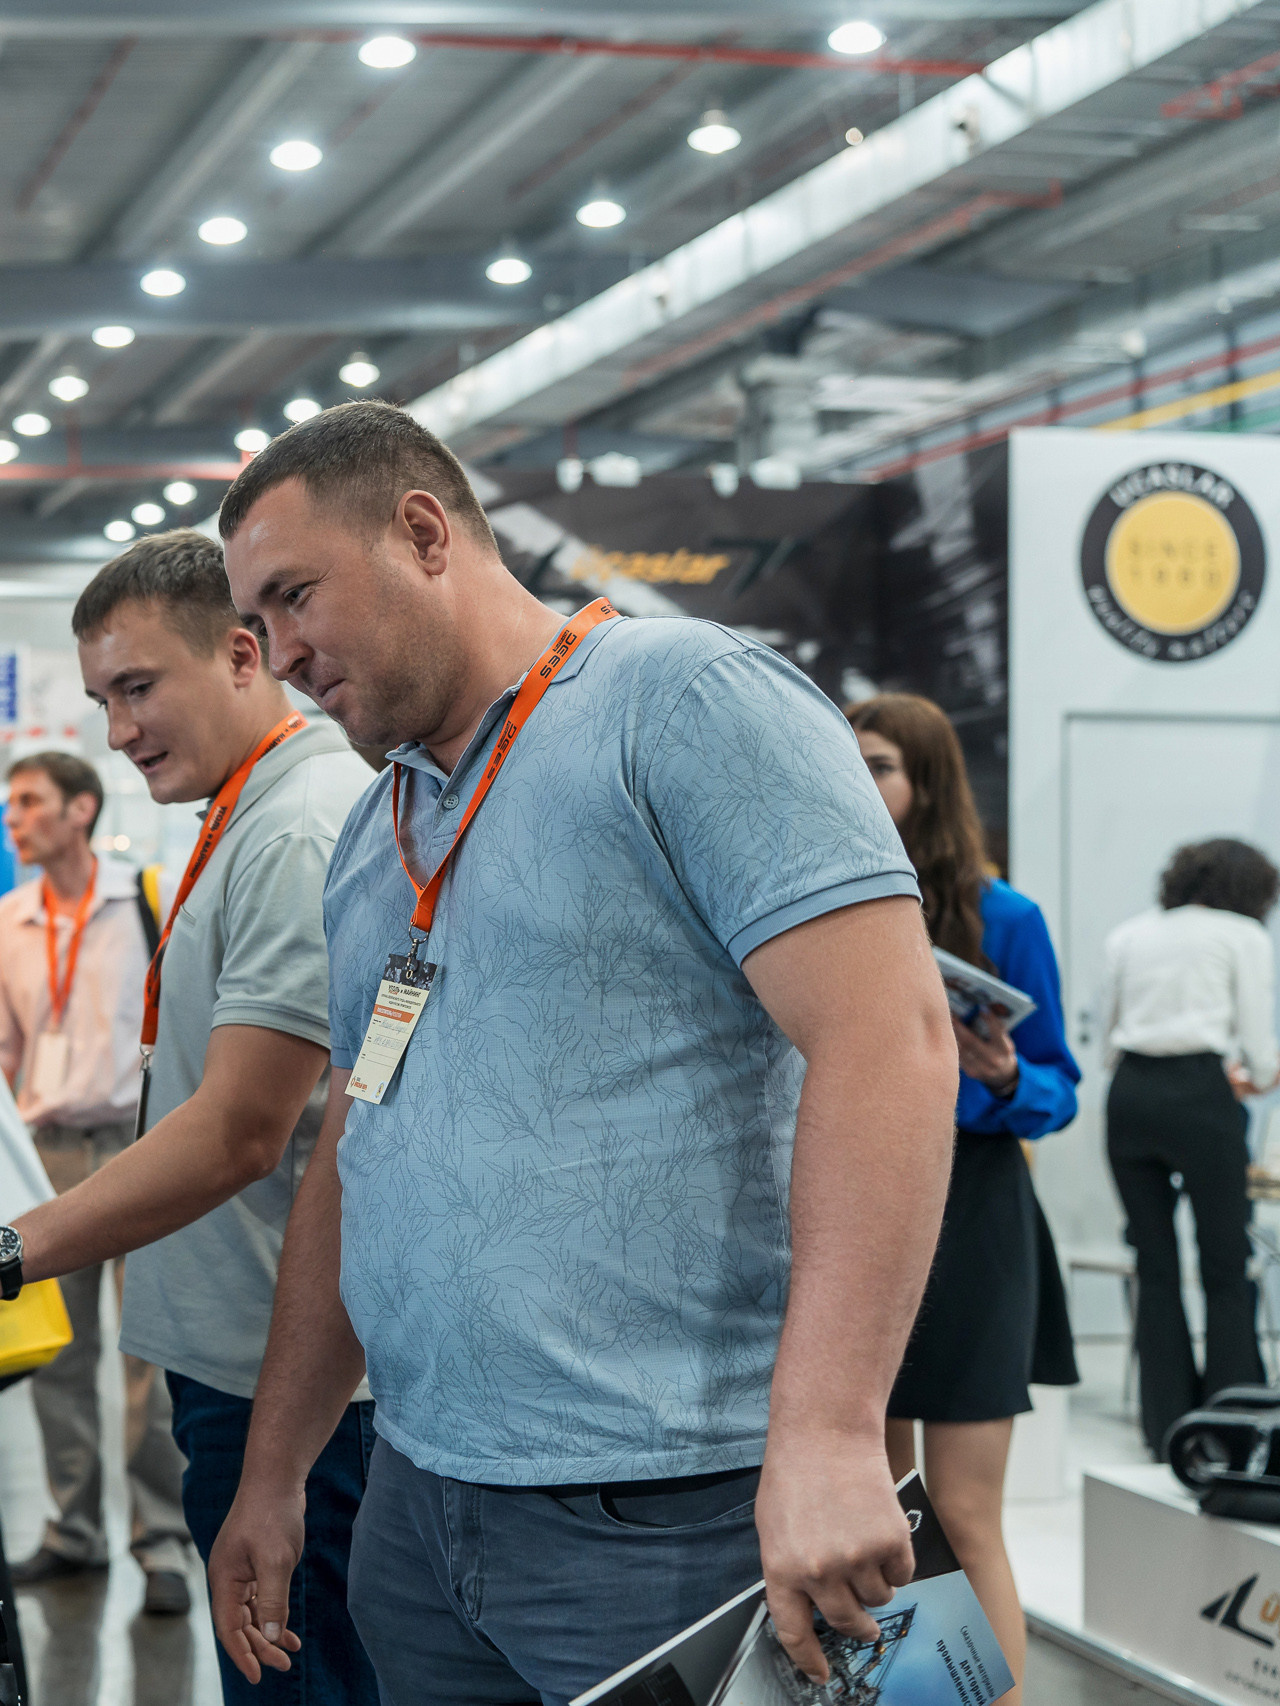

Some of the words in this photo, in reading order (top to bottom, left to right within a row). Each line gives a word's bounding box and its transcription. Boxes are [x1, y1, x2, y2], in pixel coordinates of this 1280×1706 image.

[539, 632, 578, 679] DEES
[487, 722, 518, 780] DEES
[959, 1659, 973, 1677] для
[960, 1625, 981, 1664] Смазочные
[977, 1663, 996, 1698] материалы
